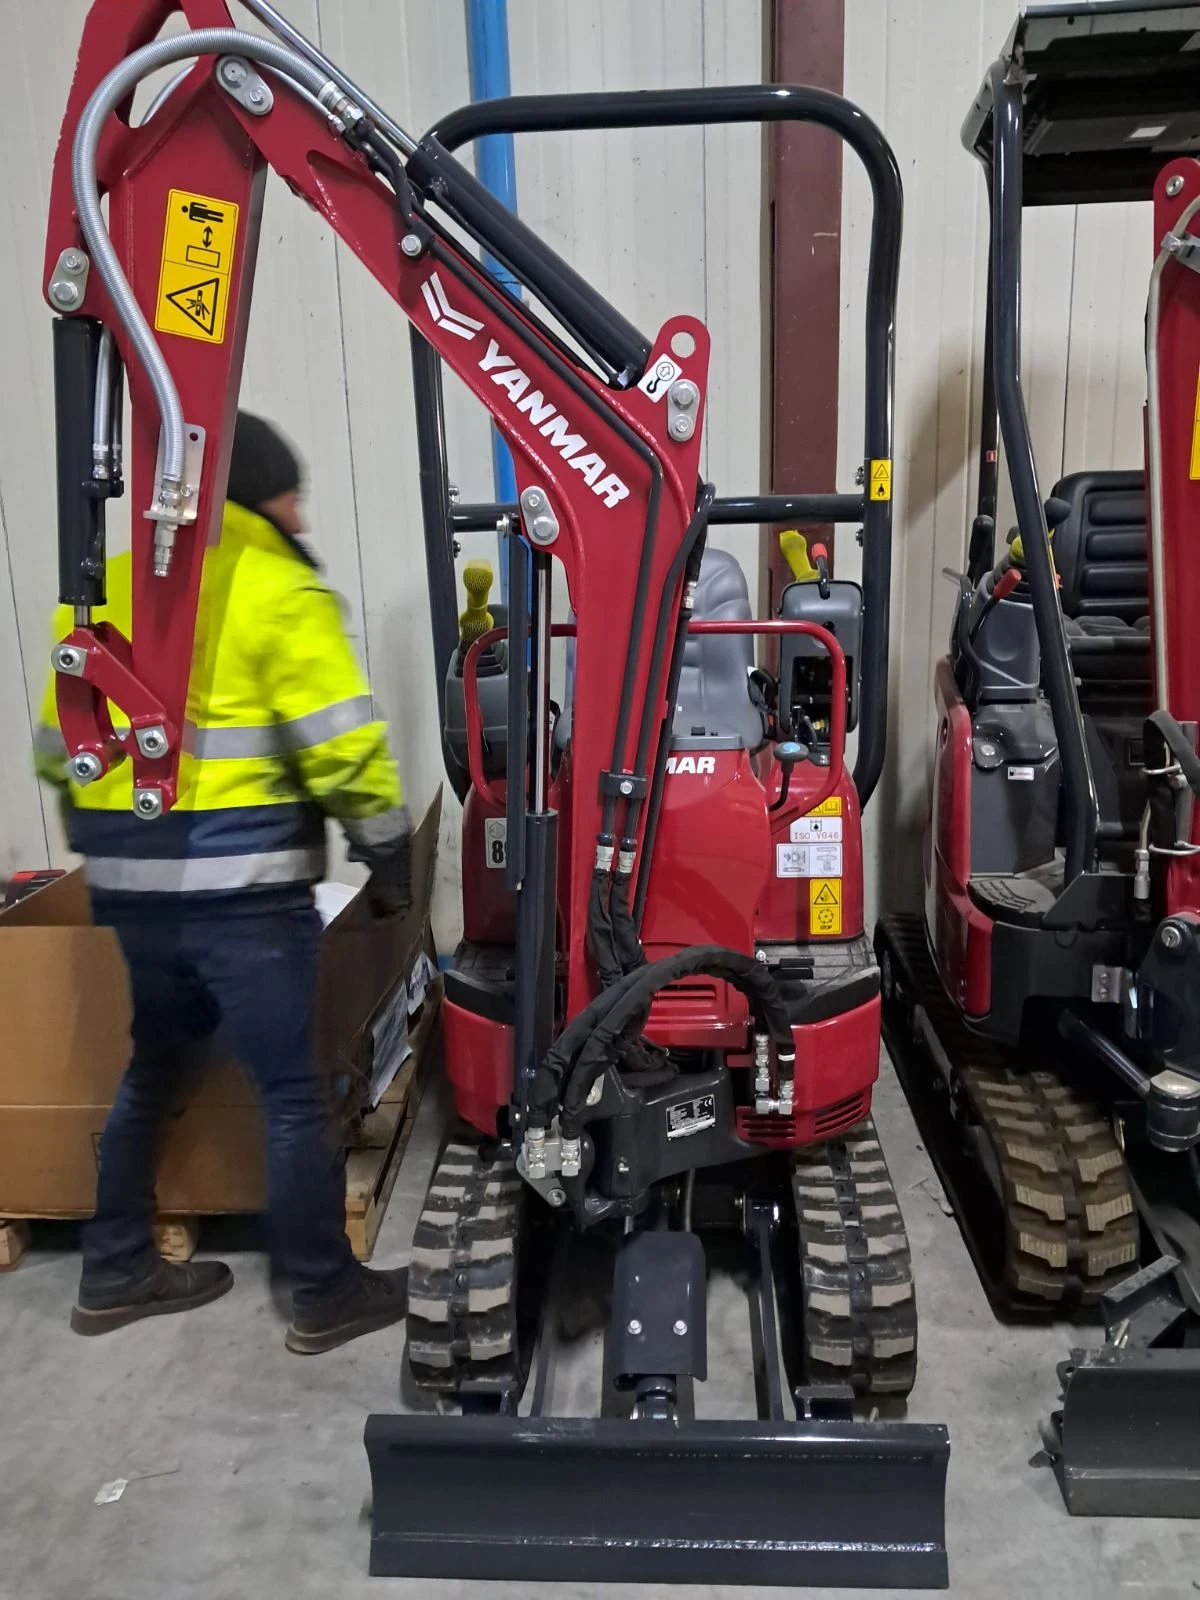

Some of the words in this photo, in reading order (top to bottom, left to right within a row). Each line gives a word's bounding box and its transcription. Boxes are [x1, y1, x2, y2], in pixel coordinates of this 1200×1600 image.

[478, 338, 630, 508] YANMAR
[794, 832, 811, 840] ISO
[491, 839, 507, 864] 8
